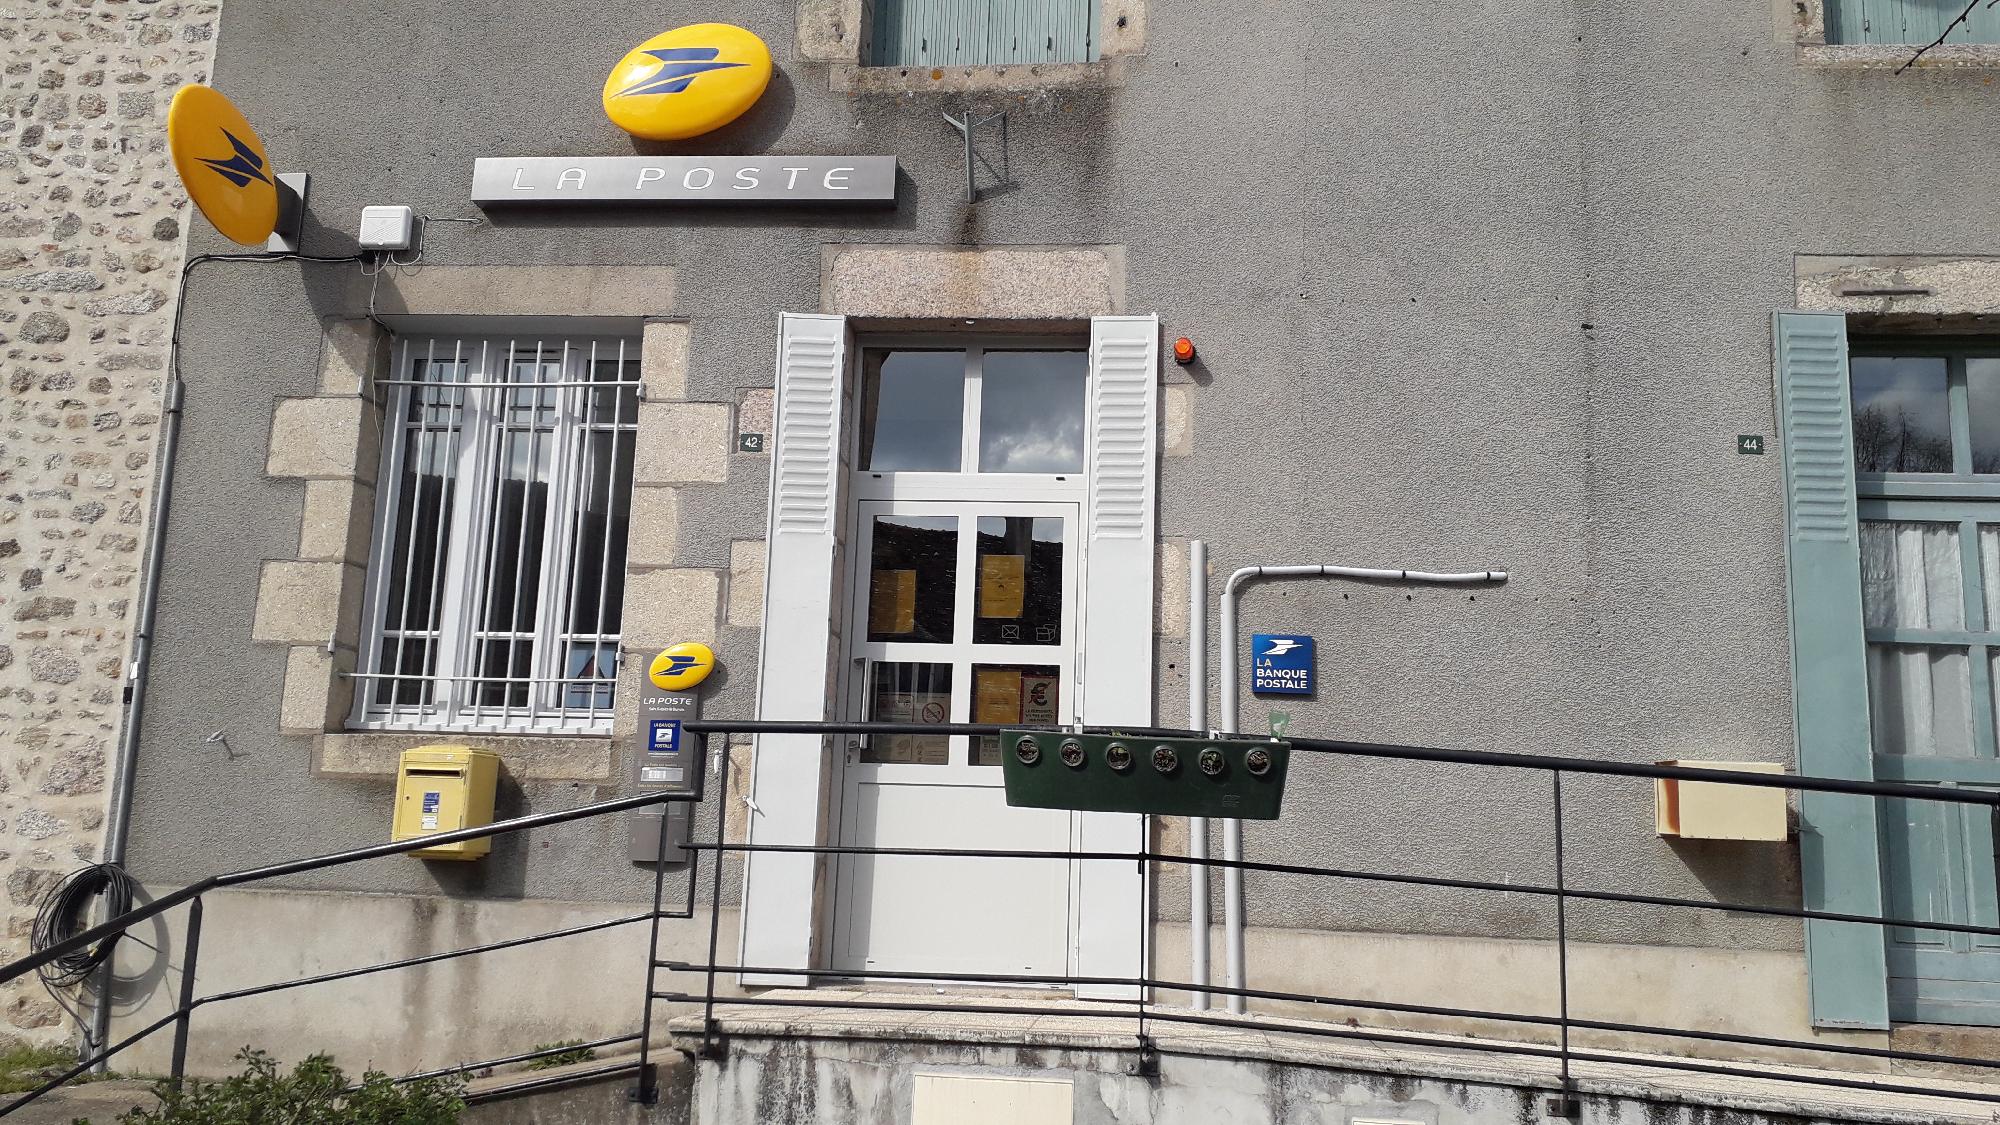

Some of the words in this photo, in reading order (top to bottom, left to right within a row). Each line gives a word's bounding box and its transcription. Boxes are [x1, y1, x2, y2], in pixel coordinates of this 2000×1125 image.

[511, 167, 587, 190] LA
[635, 166, 854, 190] POSTE
[744, 436, 758, 448] 42
[1744, 438, 1758, 450] 44
[1256, 658, 1272, 667] LA
[1256, 668, 1308, 679] BANQUE
[1256, 679, 1308, 689] POSTALE
[643, 697, 656, 705] LA
[657, 697, 693, 705] POSTE
